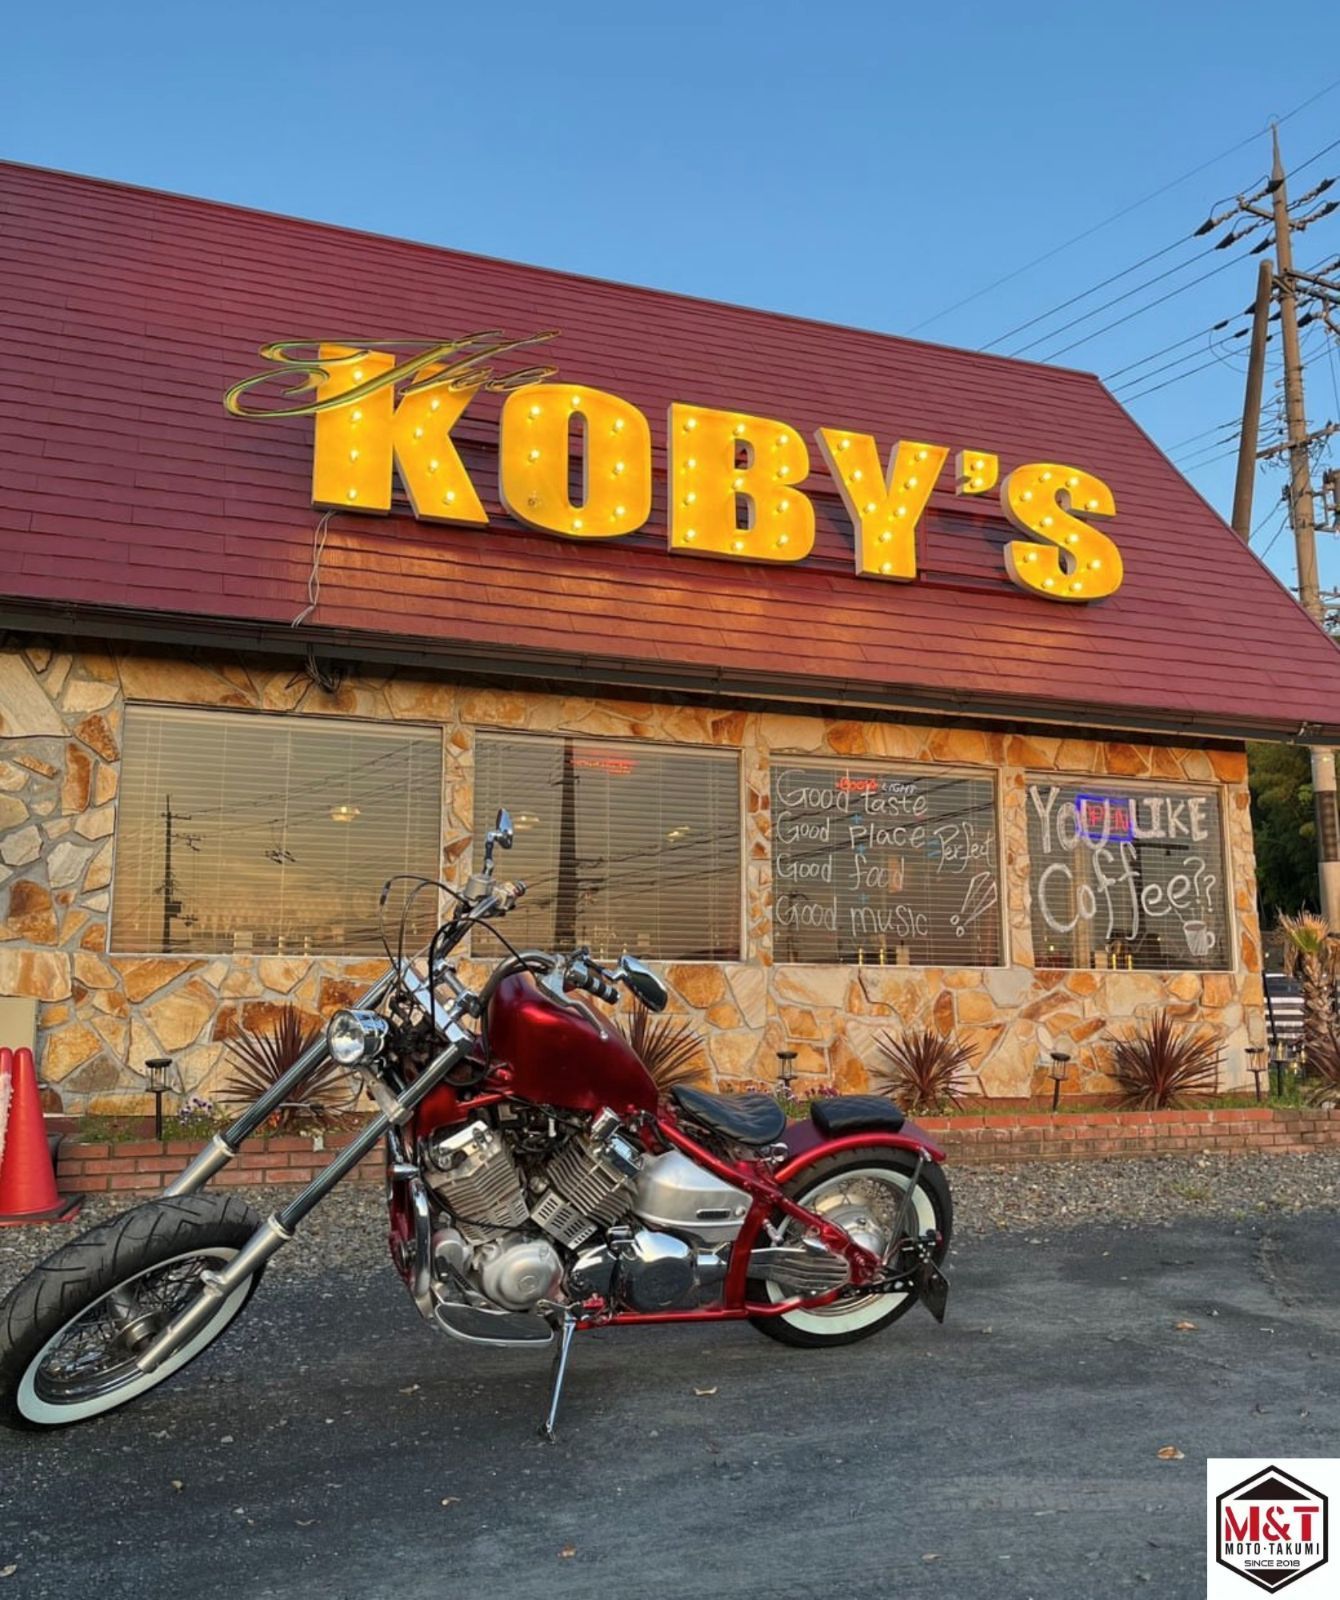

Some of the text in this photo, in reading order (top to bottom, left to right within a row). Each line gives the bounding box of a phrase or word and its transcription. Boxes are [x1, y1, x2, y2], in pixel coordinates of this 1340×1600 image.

[312, 344, 1125, 604] KOBY'S
[776, 768, 929, 816] Good taste
[776, 811, 830, 844] Good
[1129, 797, 1208, 842] LIKE
[776, 852, 833, 883] Good
[775, 895, 838, 931] Good
